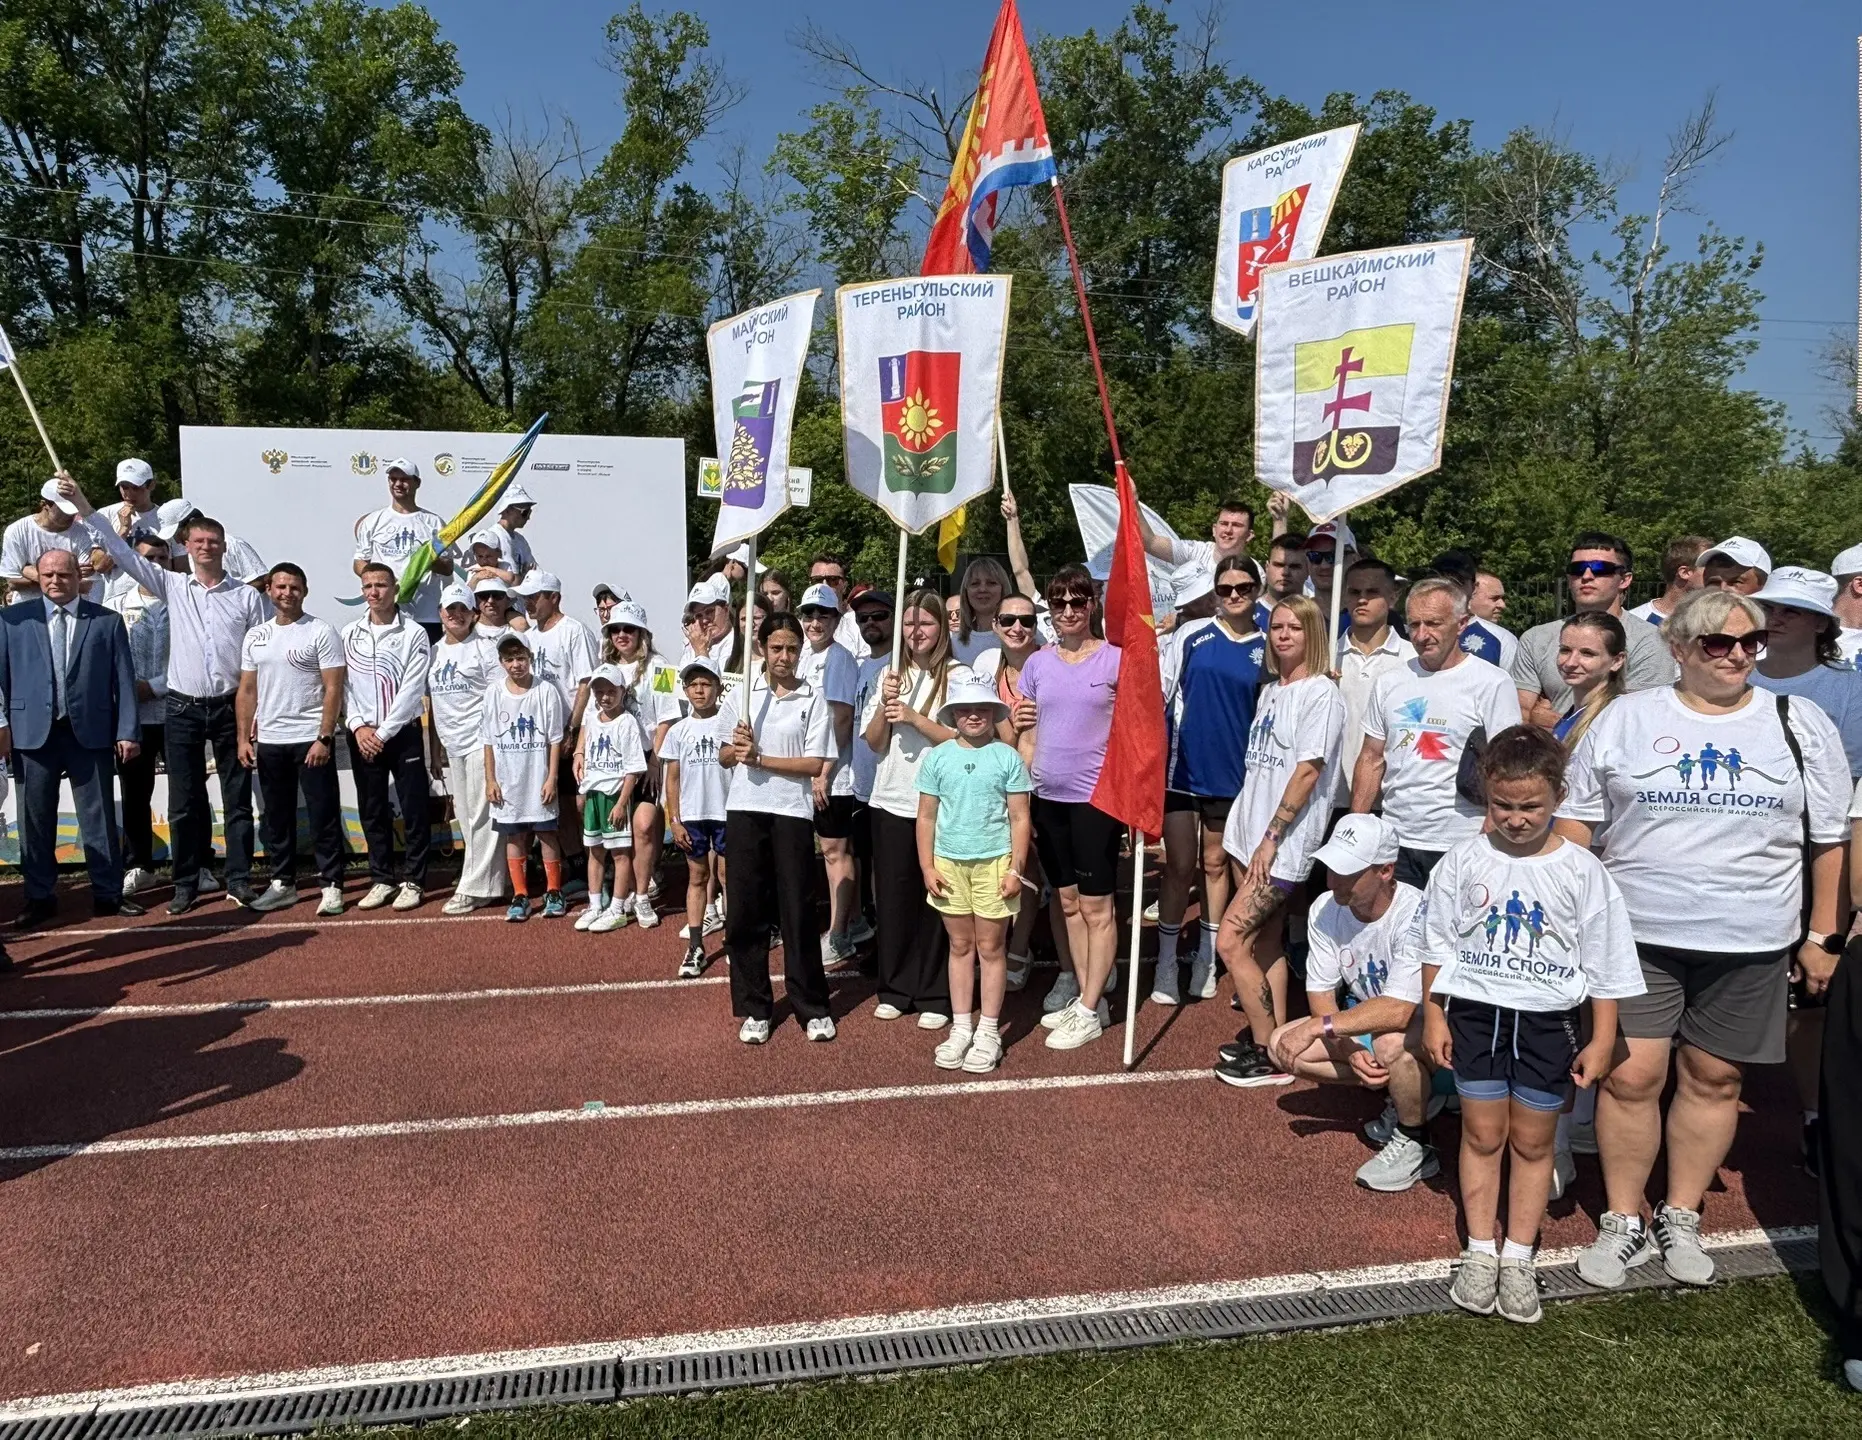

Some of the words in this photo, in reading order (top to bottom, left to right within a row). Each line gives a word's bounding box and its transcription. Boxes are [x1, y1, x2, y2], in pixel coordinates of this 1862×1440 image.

[1246, 135, 1328, 171] КАРСУНСКИЙ
[1265, 154, 1302, 179] РАОН
[1288, 248, 1435, 288] ВЕШКАЙМСКИЙ
[852, 280, 994, 308] ТЕРЕНЬГУЛЬСКИЙ
[1327, 276, 1386, 301] РАЙОН
[897, 299, 946, 320] РАЙОН
[1636, 790, 1700, 804] ЗЕМЛЯ
[1708, 793, 1784, 810] СПОРТА
[1648, 805, 1724, 814] ВСЕРОССИЙСКИЙ
[1728, 810, 1770, 818] МАРАФОН
[1460, 950, 1501, 968] ЗЕМЛЯ
[1507, 957, 1575, 979] СПОРТА
